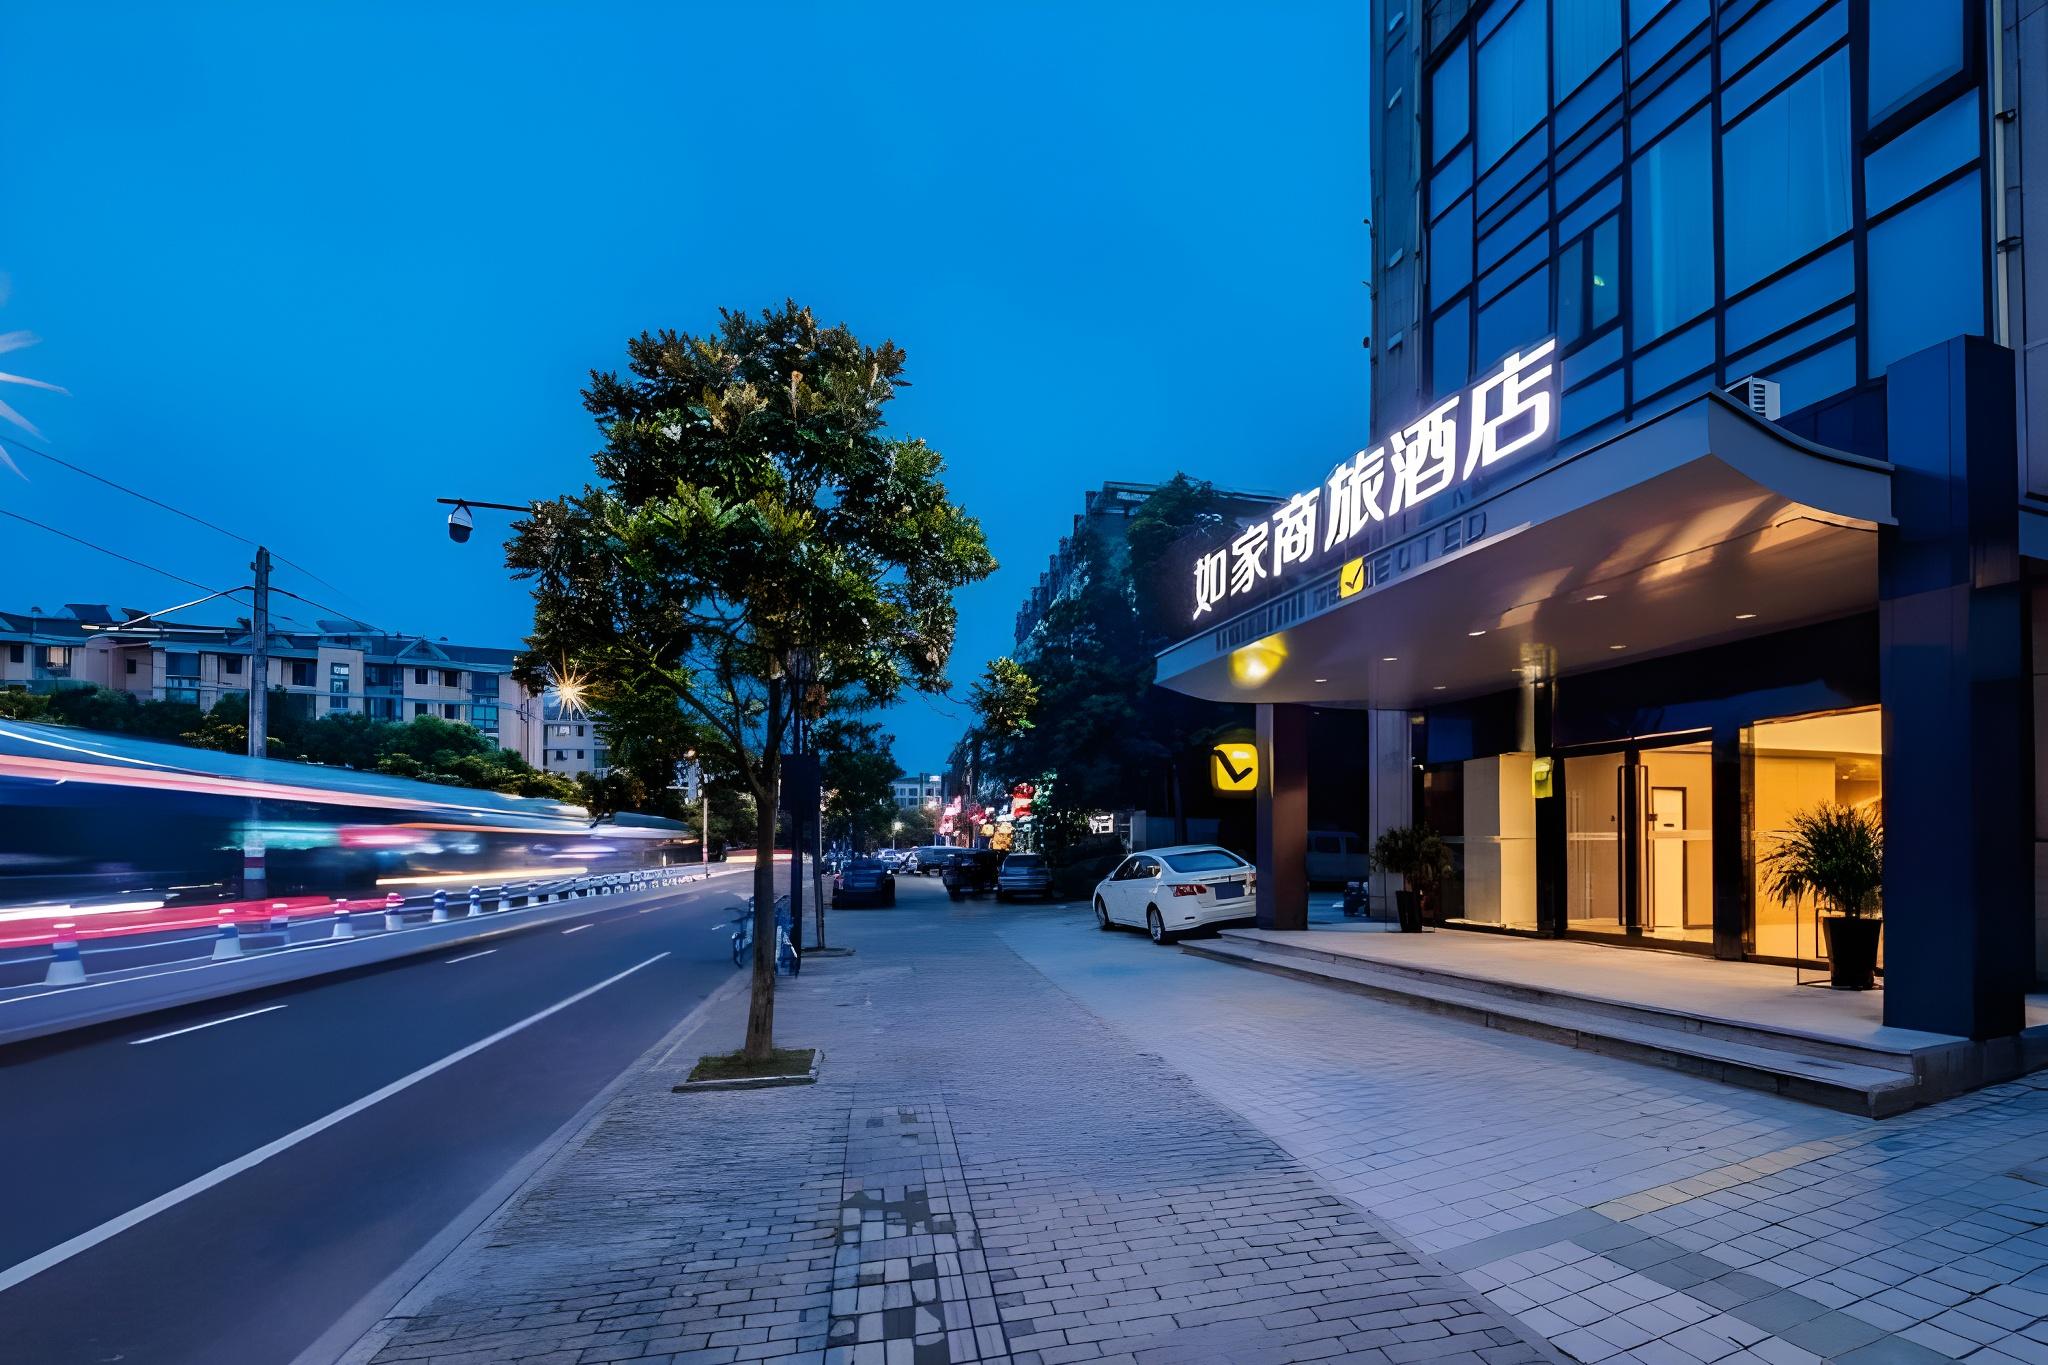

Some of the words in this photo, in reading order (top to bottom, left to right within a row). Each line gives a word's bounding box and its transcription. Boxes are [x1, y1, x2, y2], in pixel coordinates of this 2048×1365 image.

[1193, 338, 1556, 620] 如家商旅酒店
